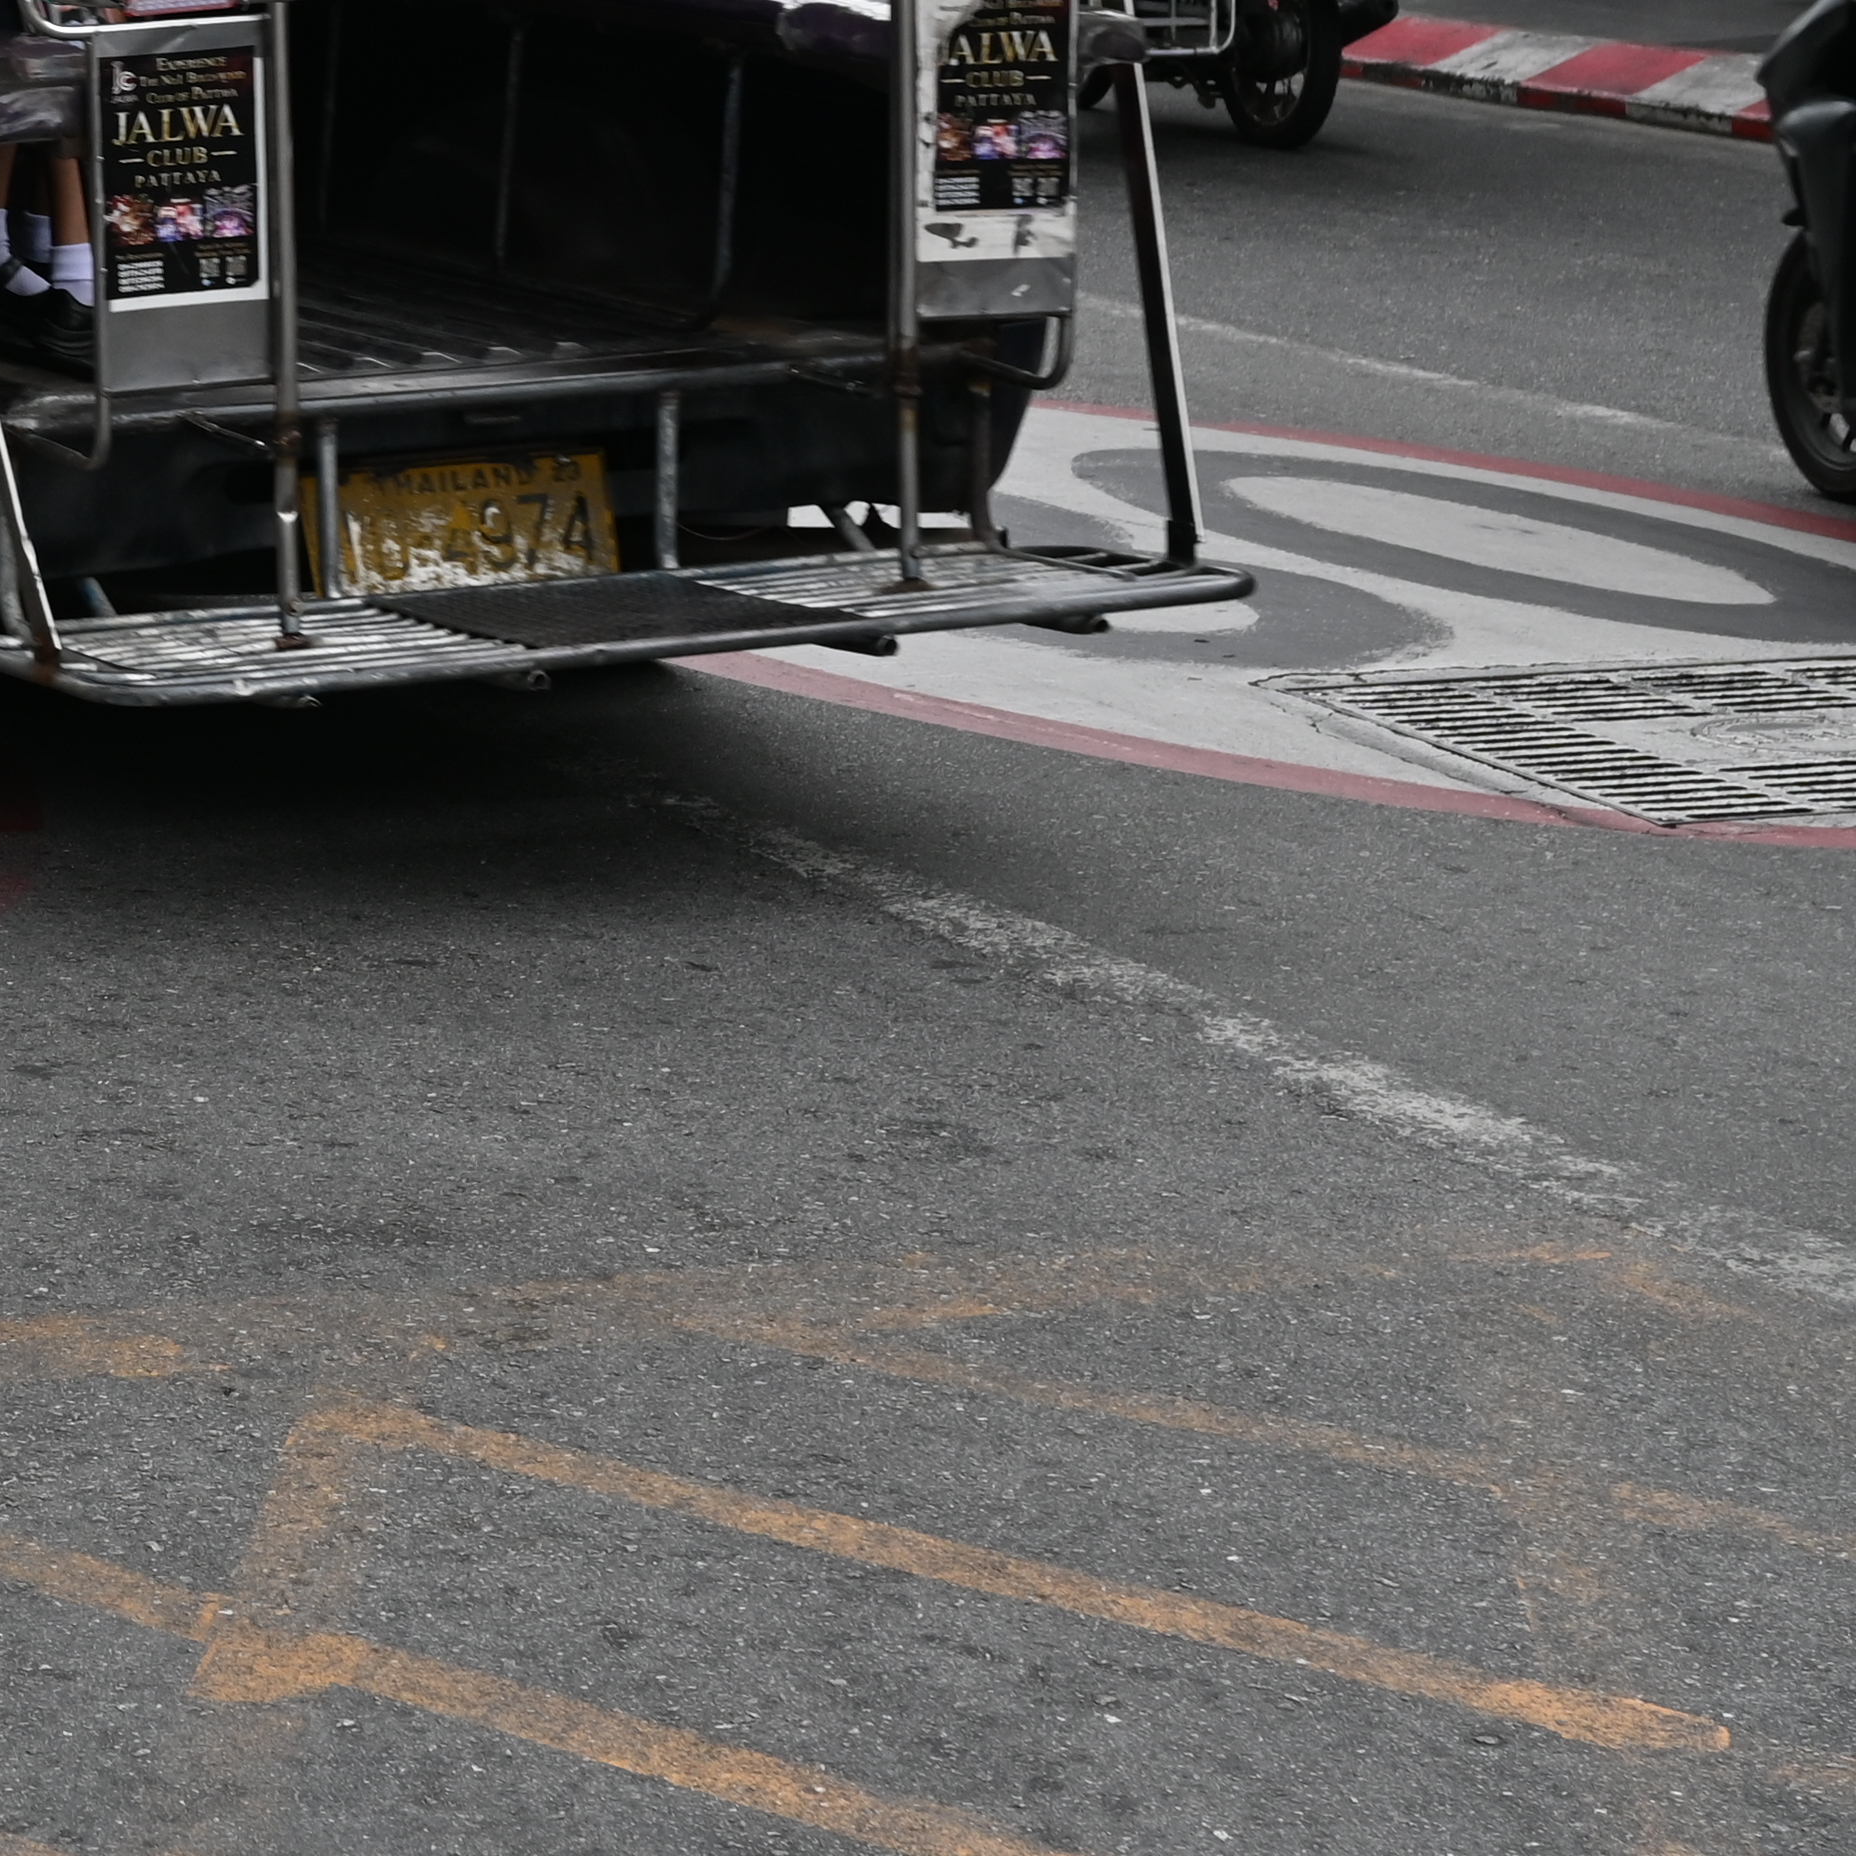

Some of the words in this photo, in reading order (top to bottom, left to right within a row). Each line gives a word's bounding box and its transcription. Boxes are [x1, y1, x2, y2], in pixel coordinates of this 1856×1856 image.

[948, 29, 1061, 67] ALWA
[965, 69, 1025, 89] CLUB
[953, 93, 1038, 107] PATTAYA
[111, 103, 246, 147] JALWA
[146, 146, 209, 168] CLUB
[134, 169, 222, 189] PATTAYA
